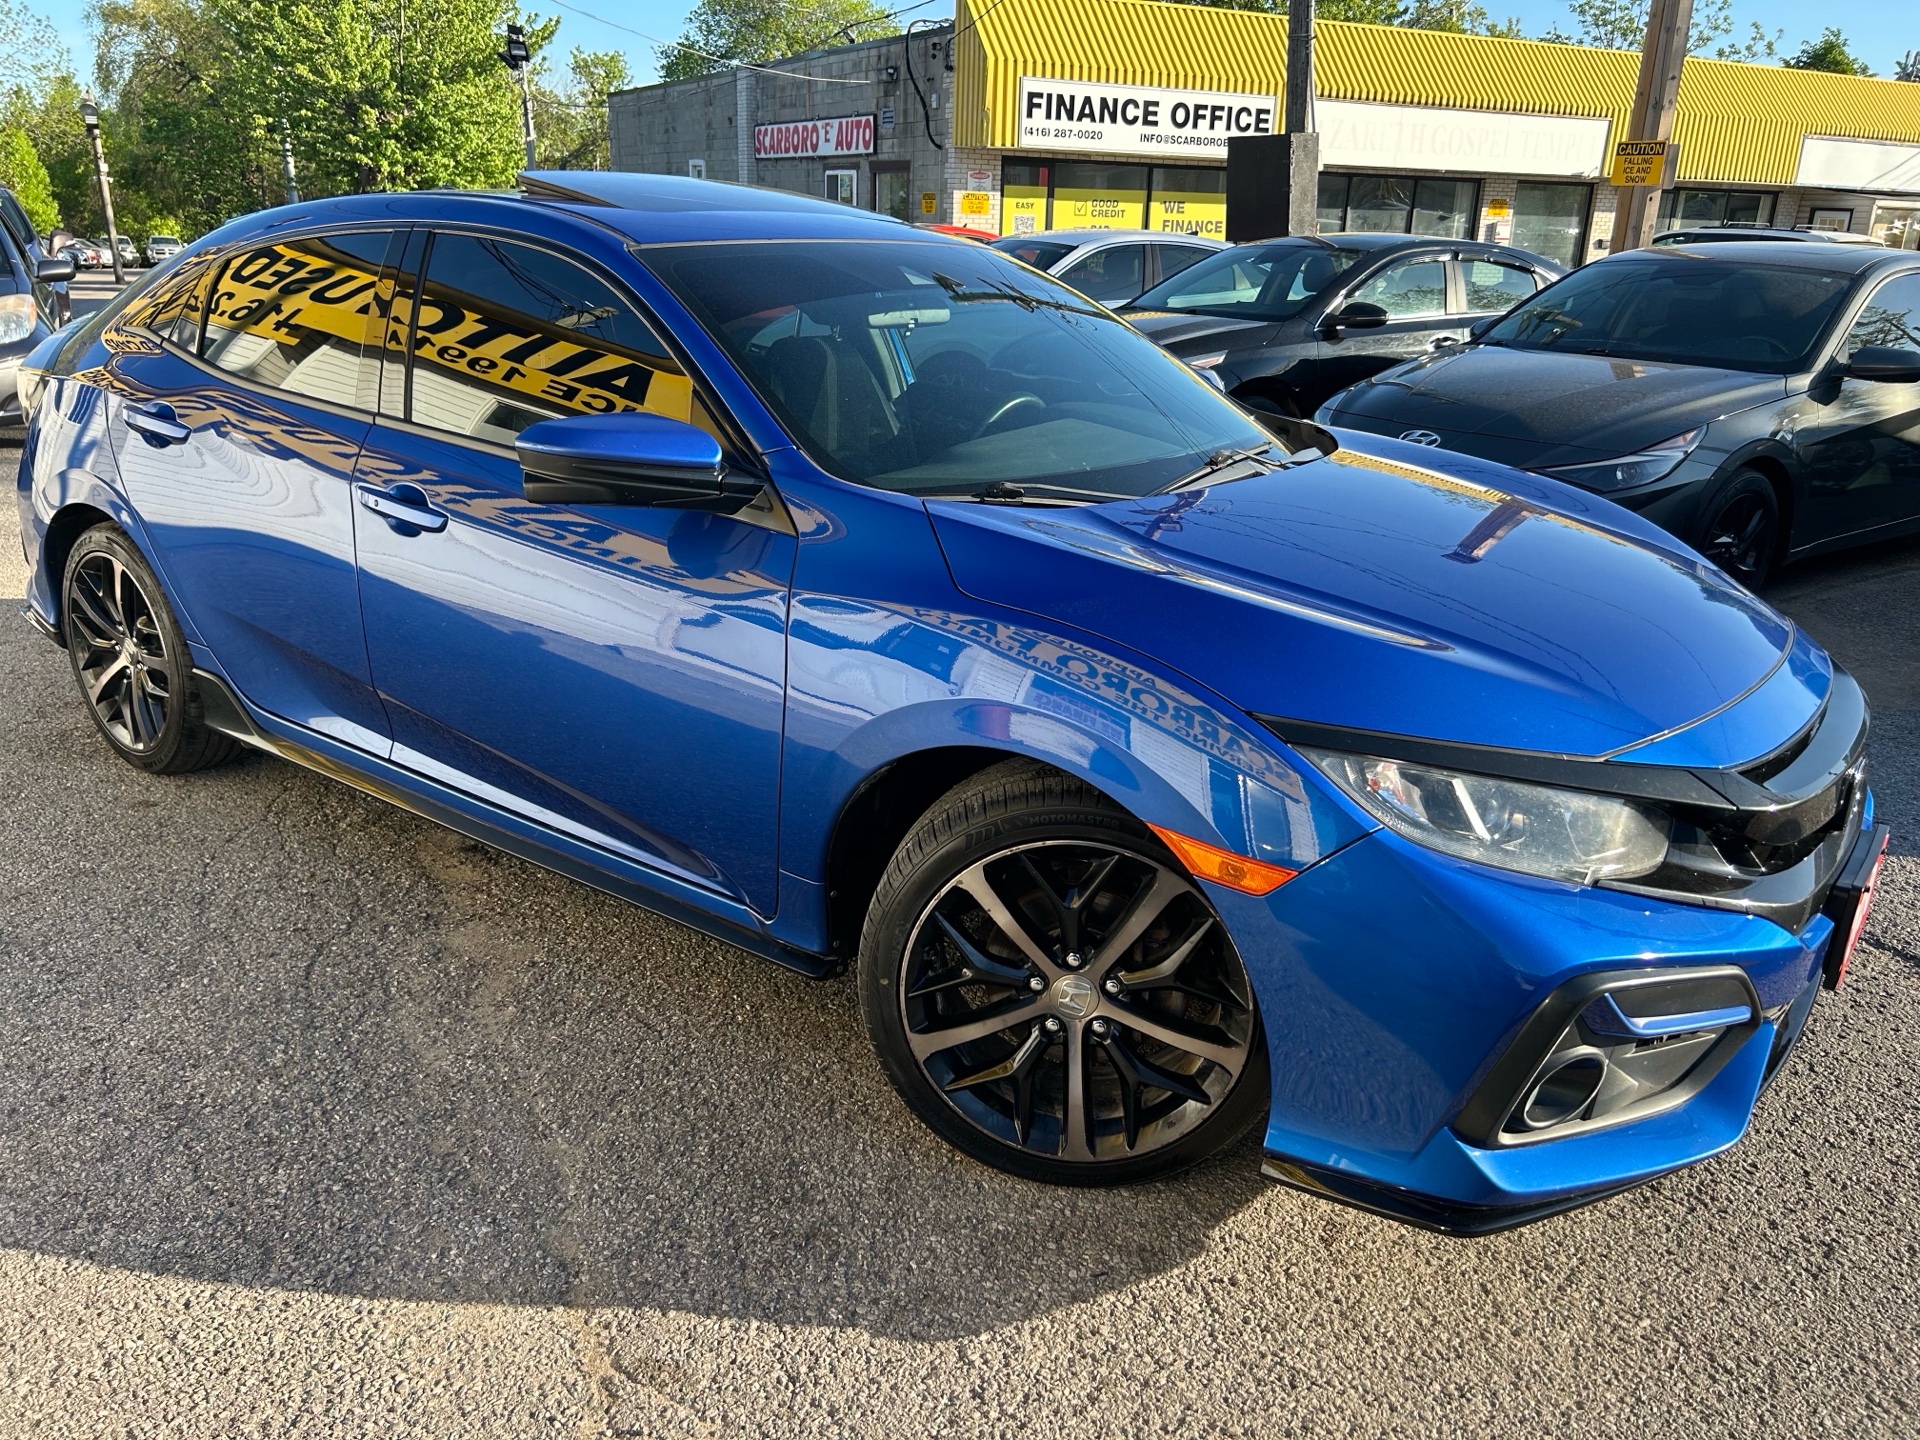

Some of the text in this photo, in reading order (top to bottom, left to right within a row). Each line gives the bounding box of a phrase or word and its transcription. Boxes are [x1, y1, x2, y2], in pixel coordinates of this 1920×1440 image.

[1026, 91, 1271, 134] FINANCE OFFICE
[755, 123, 819, 156] SCARBORO
[834, 117, 872, 151] AUTO
[1024, 126, 1103, 140] (416) 287-0020
[1618, 143, 1664, 155] CAUTION
[1623, 156, 1654, 166] FALLING
[1623, 166, 1651, 174] ICE AND
[1624, 175, 1647, 184] SNOW
[1015, 202, 1035, 210] EASY
[1091, 199, 1119, 209] GOOD
[1162, 201, 1186, 214] WE
[1091, 209, 1126, 218] CREDIT
[1162, 219, 1224, 233] FINANCE
[1029, 813, 1121, 830] MOTOMASTER
